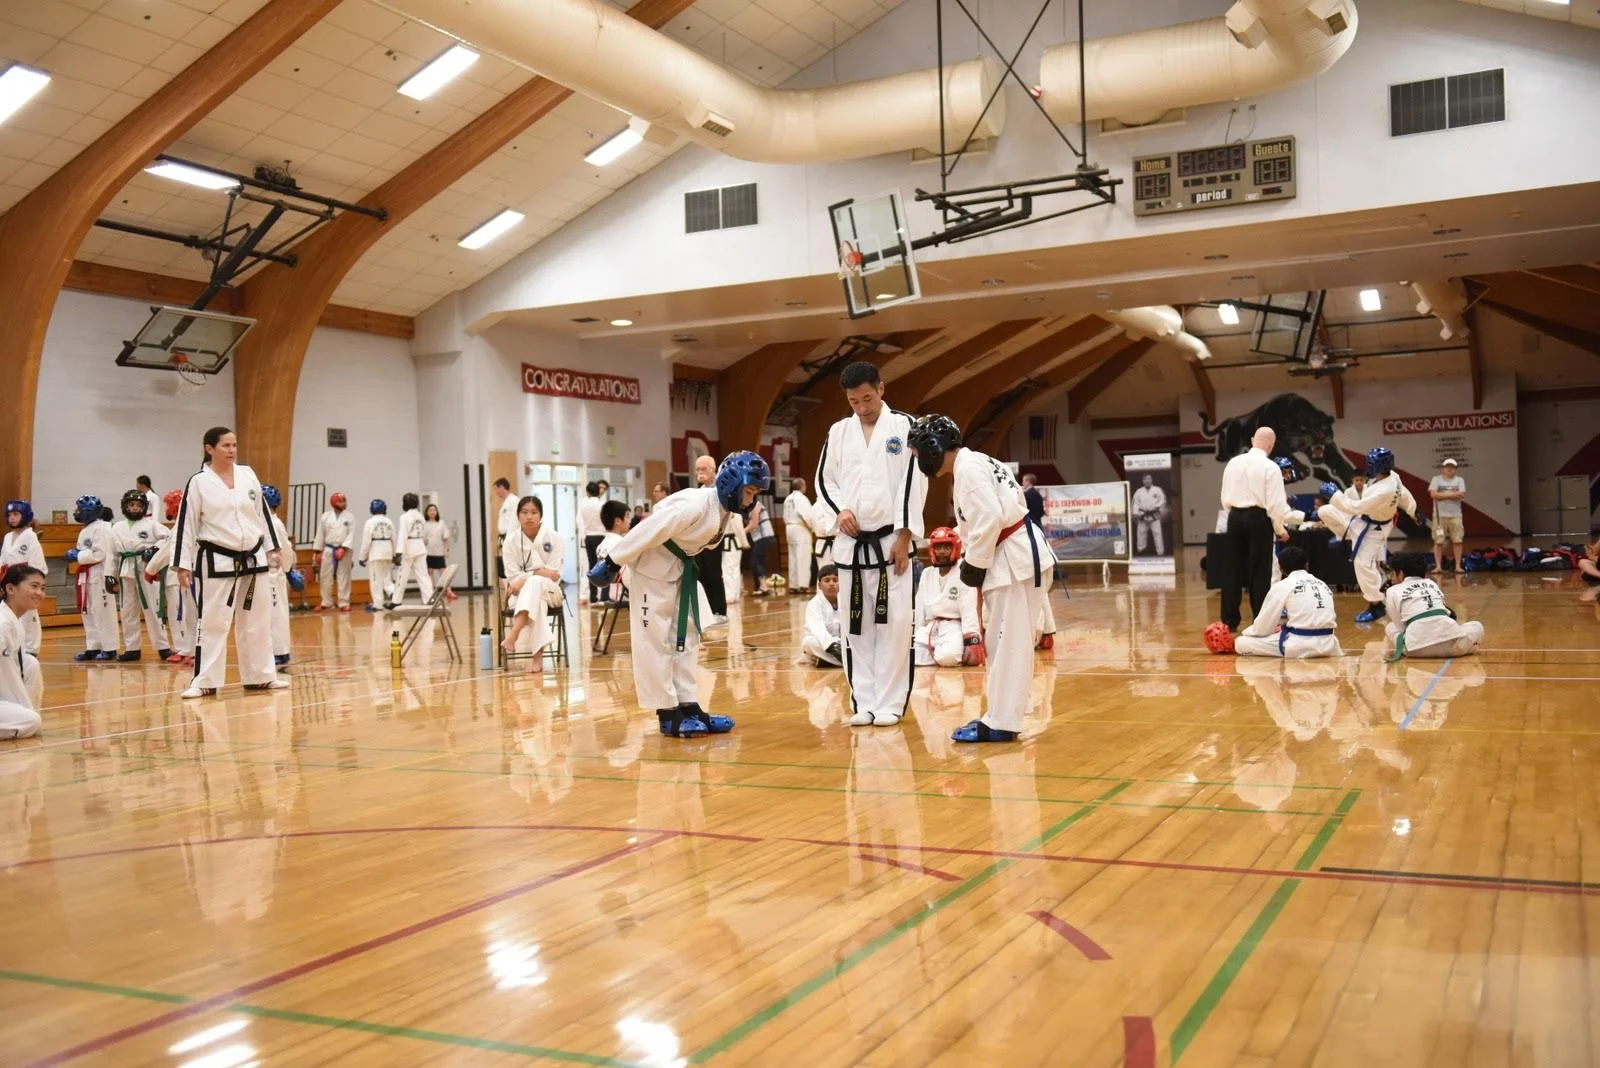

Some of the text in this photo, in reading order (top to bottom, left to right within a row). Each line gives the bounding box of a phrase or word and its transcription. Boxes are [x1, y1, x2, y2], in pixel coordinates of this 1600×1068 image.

[1255, 142, 1289, 157] Guests
[1140, 159, 1166, 172] Home
[1196, 188, 1227, 204] period
[524, 367, 640, 400] CONGRATULATIONS!
[1384, 412, 1513, 433] CONGRATULATIONS!
[641, 593, 649, 628] ITF
[851, 610, 861, 619] IV
